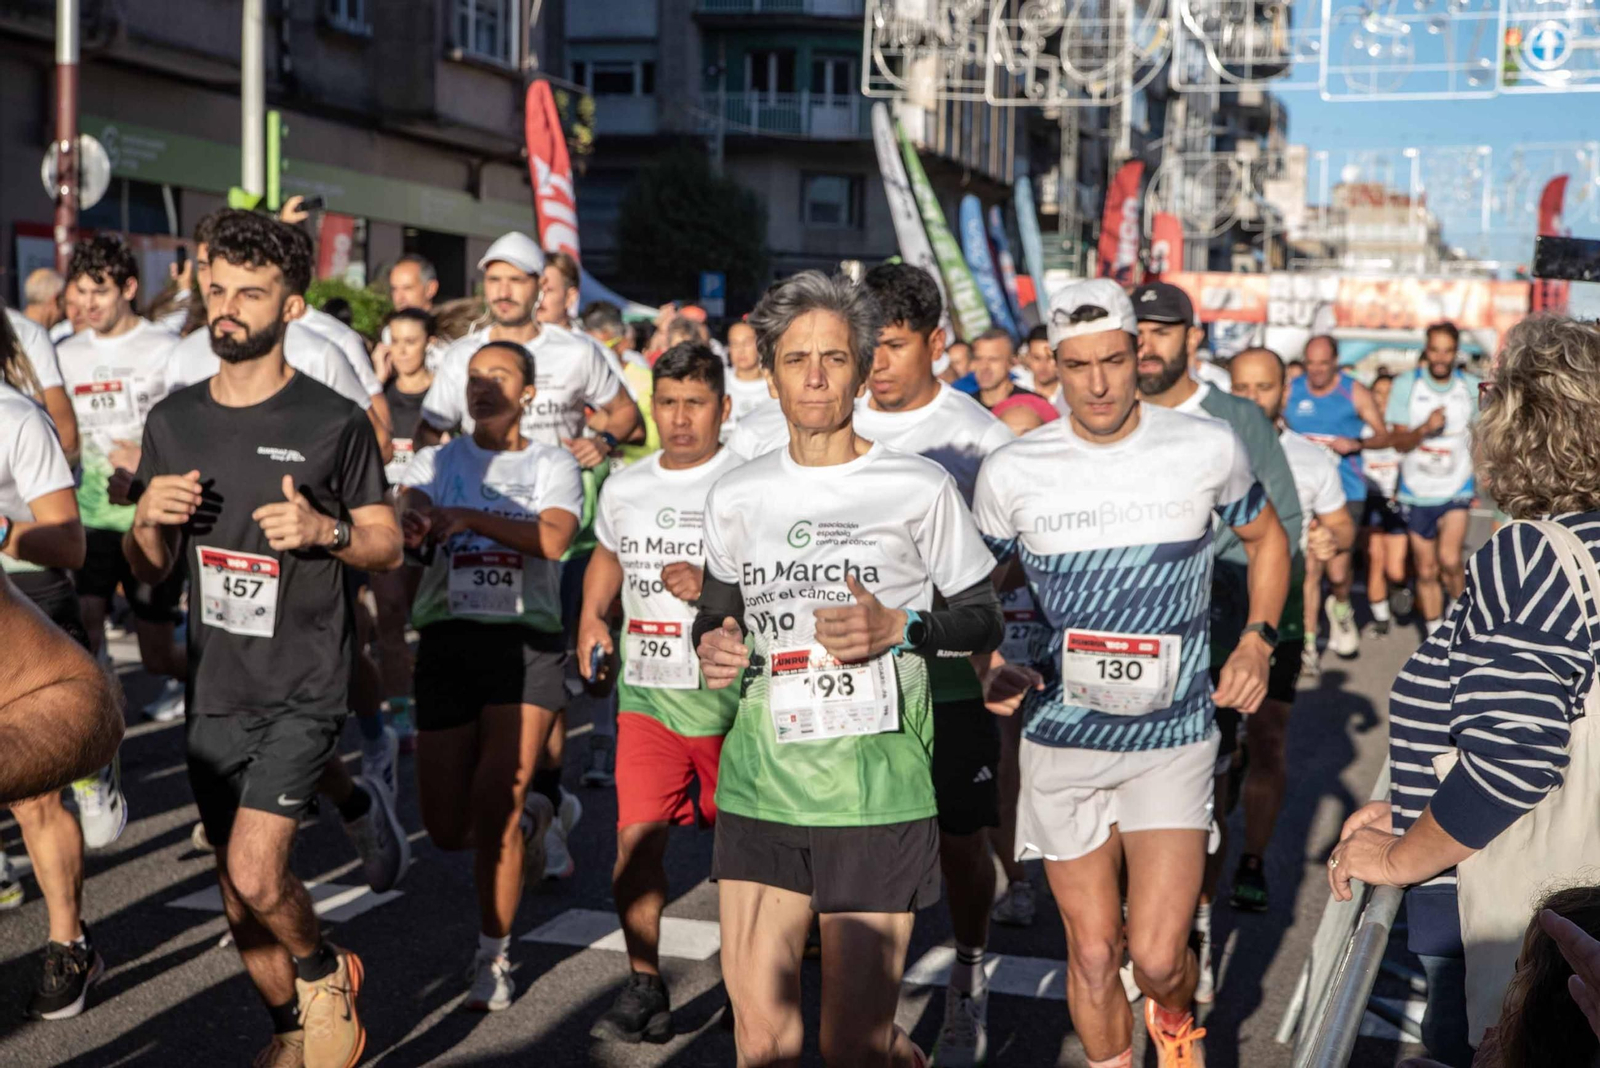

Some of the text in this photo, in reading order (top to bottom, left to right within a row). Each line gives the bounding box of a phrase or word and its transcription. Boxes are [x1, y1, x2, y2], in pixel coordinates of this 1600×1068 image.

[818, 521, 859, 529] asociación
[620, 536, 639, 554] En
[815, 538, 838, 546] contra
[850, 538, 878, 546] cáncer
[473, 569, 513, 587] 304
[742, 558, 880, 587] En Marcha
[223, 576, 264, 599] 457
[779, 588, 796, 599] el
[640, 640, 671, 658] 296
[1096, 659, 1142, 680] 130
